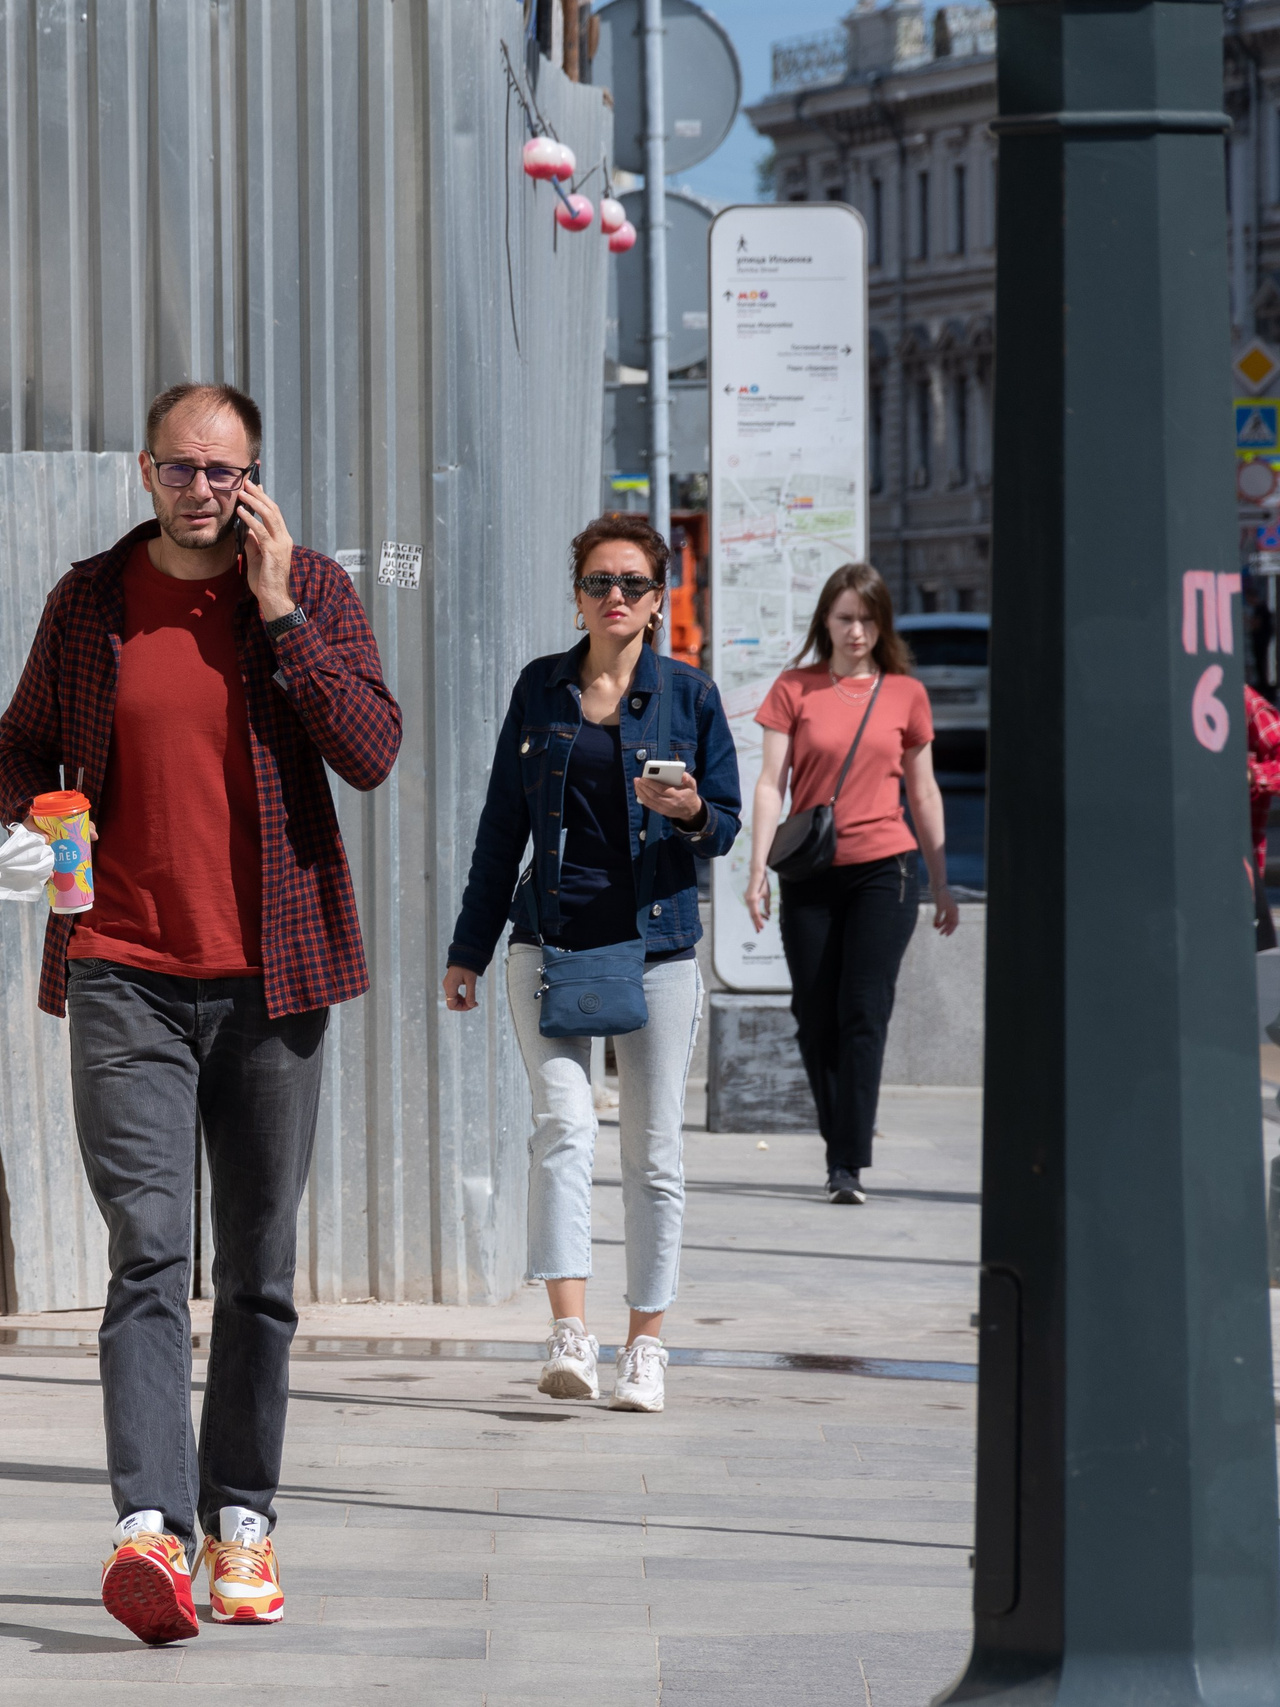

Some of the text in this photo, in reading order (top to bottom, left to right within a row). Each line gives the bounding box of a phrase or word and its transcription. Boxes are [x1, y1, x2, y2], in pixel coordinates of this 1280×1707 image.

[737, 254, 813, 267] улица Ильинка
[384, 551, 419, 562] NAMER
[386, 560, 415, 570] JUICE
[378, 576, 418, 587] CATEK
[1192, 664, 1229, 752] 6
